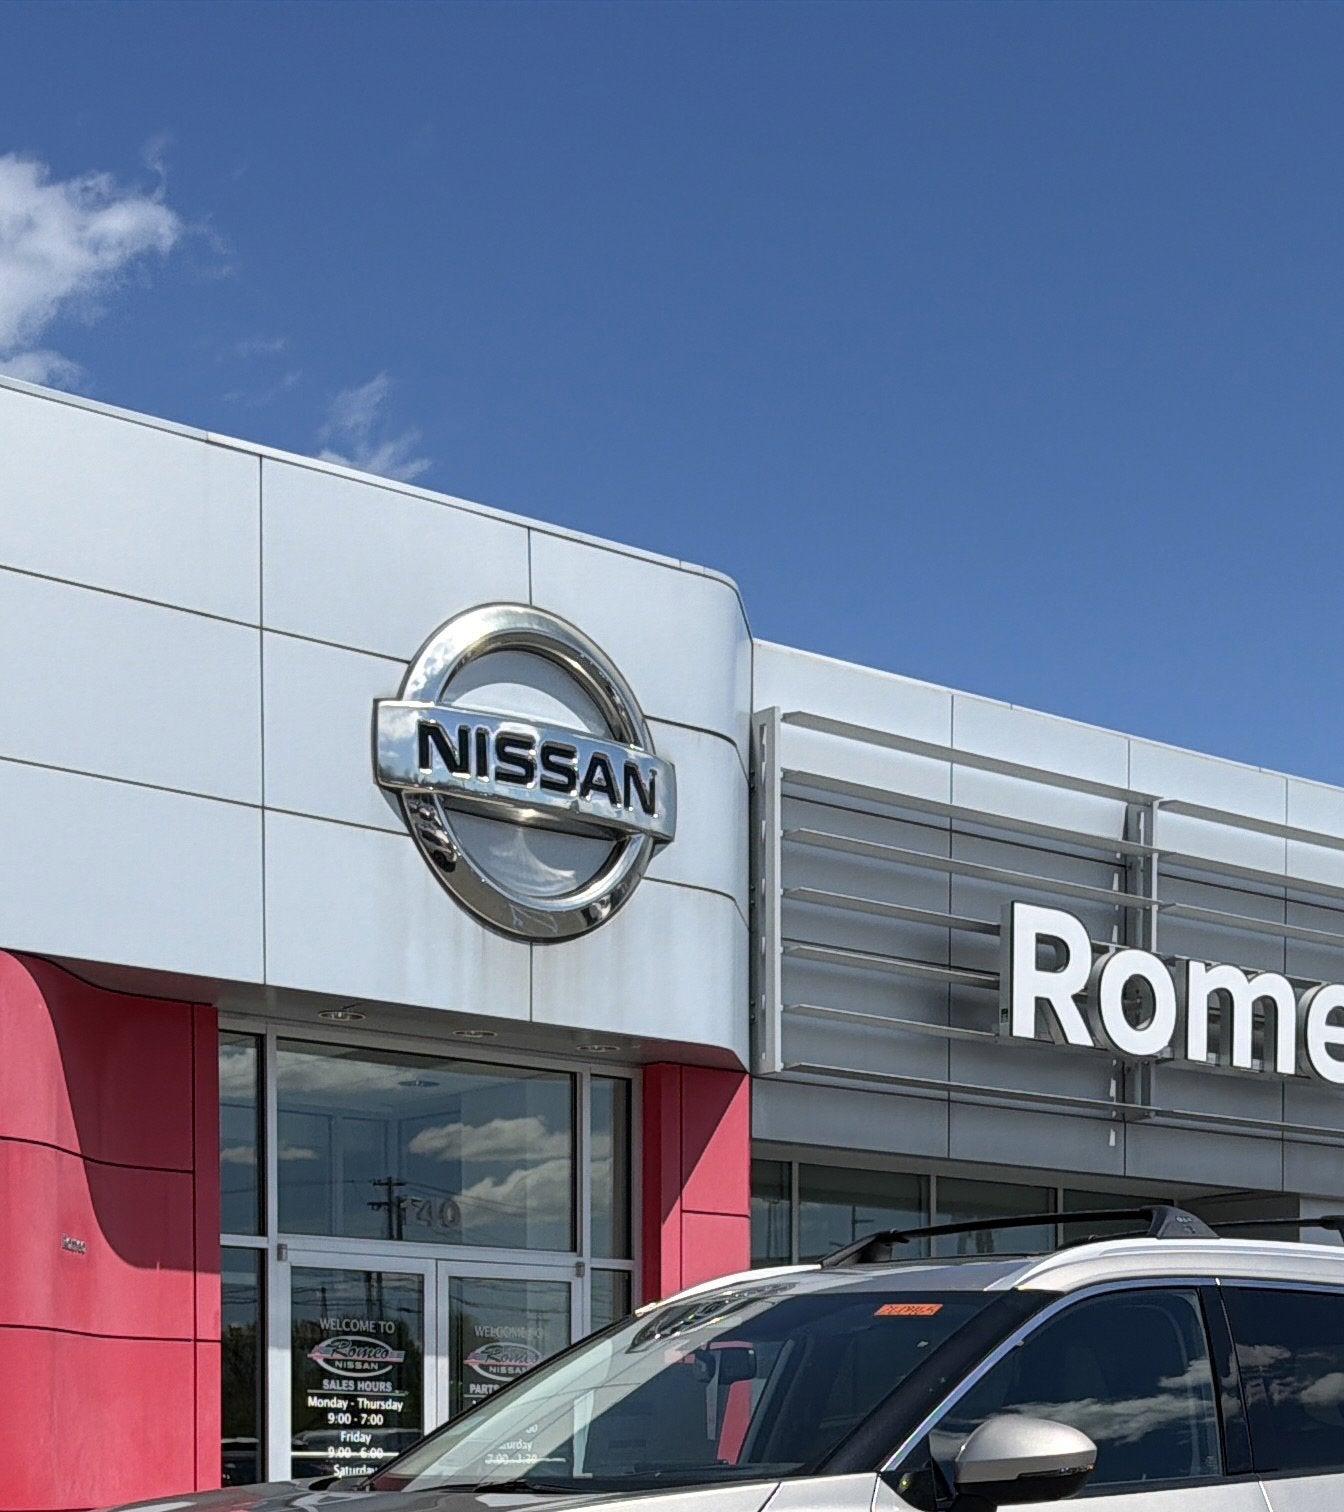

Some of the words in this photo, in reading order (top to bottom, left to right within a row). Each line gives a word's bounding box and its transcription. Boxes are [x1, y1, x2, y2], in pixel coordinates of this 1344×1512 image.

[417, 719, 658, 818] NISSAN
[320, 1319, 377, 1333] WELCOME
[379, 1321, 395, 1334] TO
[325, 1338, 391, 1359] Romeo
[335, 1361, 378, 1370] NISSAN
[323, 1379, 355, 1391] SALES
[357, 1381, 392, 1393] HOURS
[307, 1396, 348, 1410] Monday
[356, 1398, 404, 1412] Thursday
[327, 1413, 351, 1424] 9:00
[361, 1414, 384, 1425] 7:00
[340, 1430, 372, 1445] Friday
[327, 1446, 351, 1458] 9:00
[360, 1447, 384, 1459] 6:00
